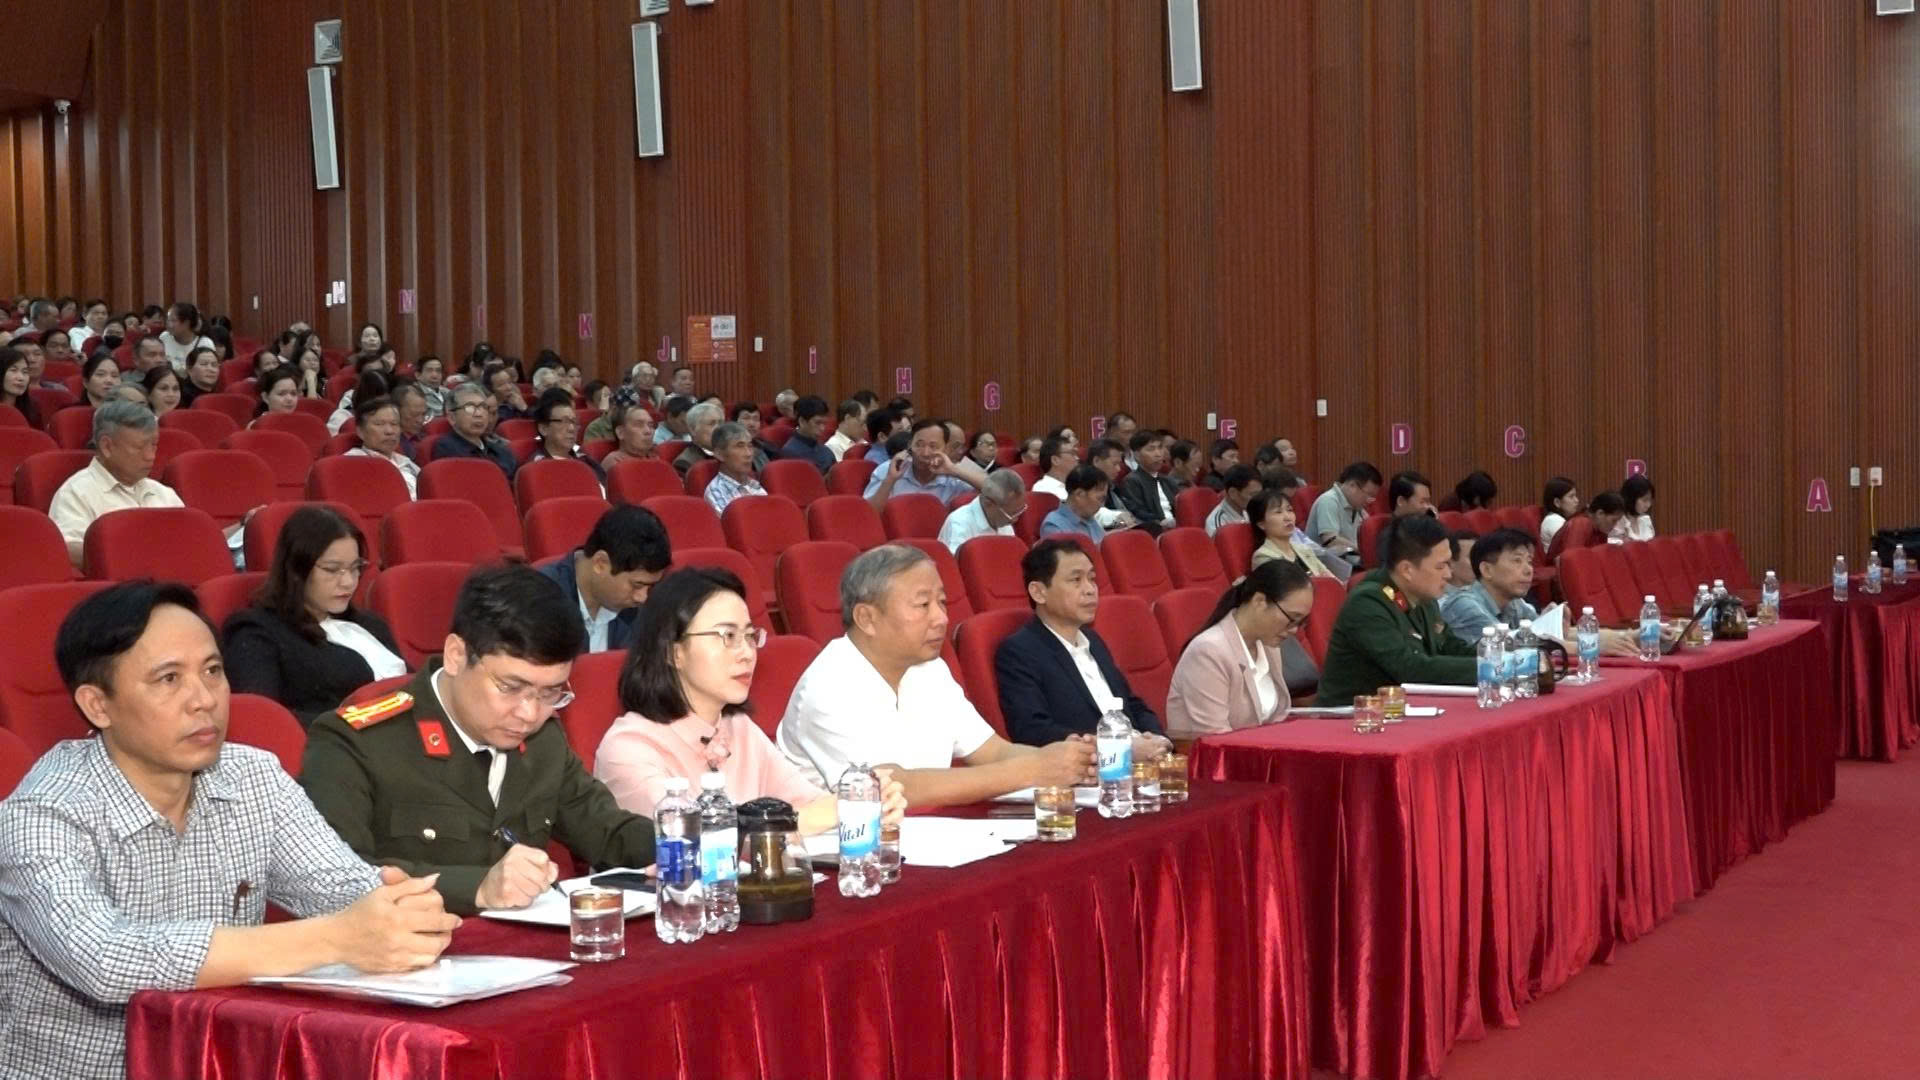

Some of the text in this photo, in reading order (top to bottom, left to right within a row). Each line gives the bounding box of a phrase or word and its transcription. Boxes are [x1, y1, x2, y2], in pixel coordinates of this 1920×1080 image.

[657, 335, 670, 362] J
[896, 367, 912, 394] H
[984, 382, 1001, 411] G
[1392, 423, 1412, 455] D
[1504, 425, 1526, 458] C
[1806, 479, 1832, 512] A
